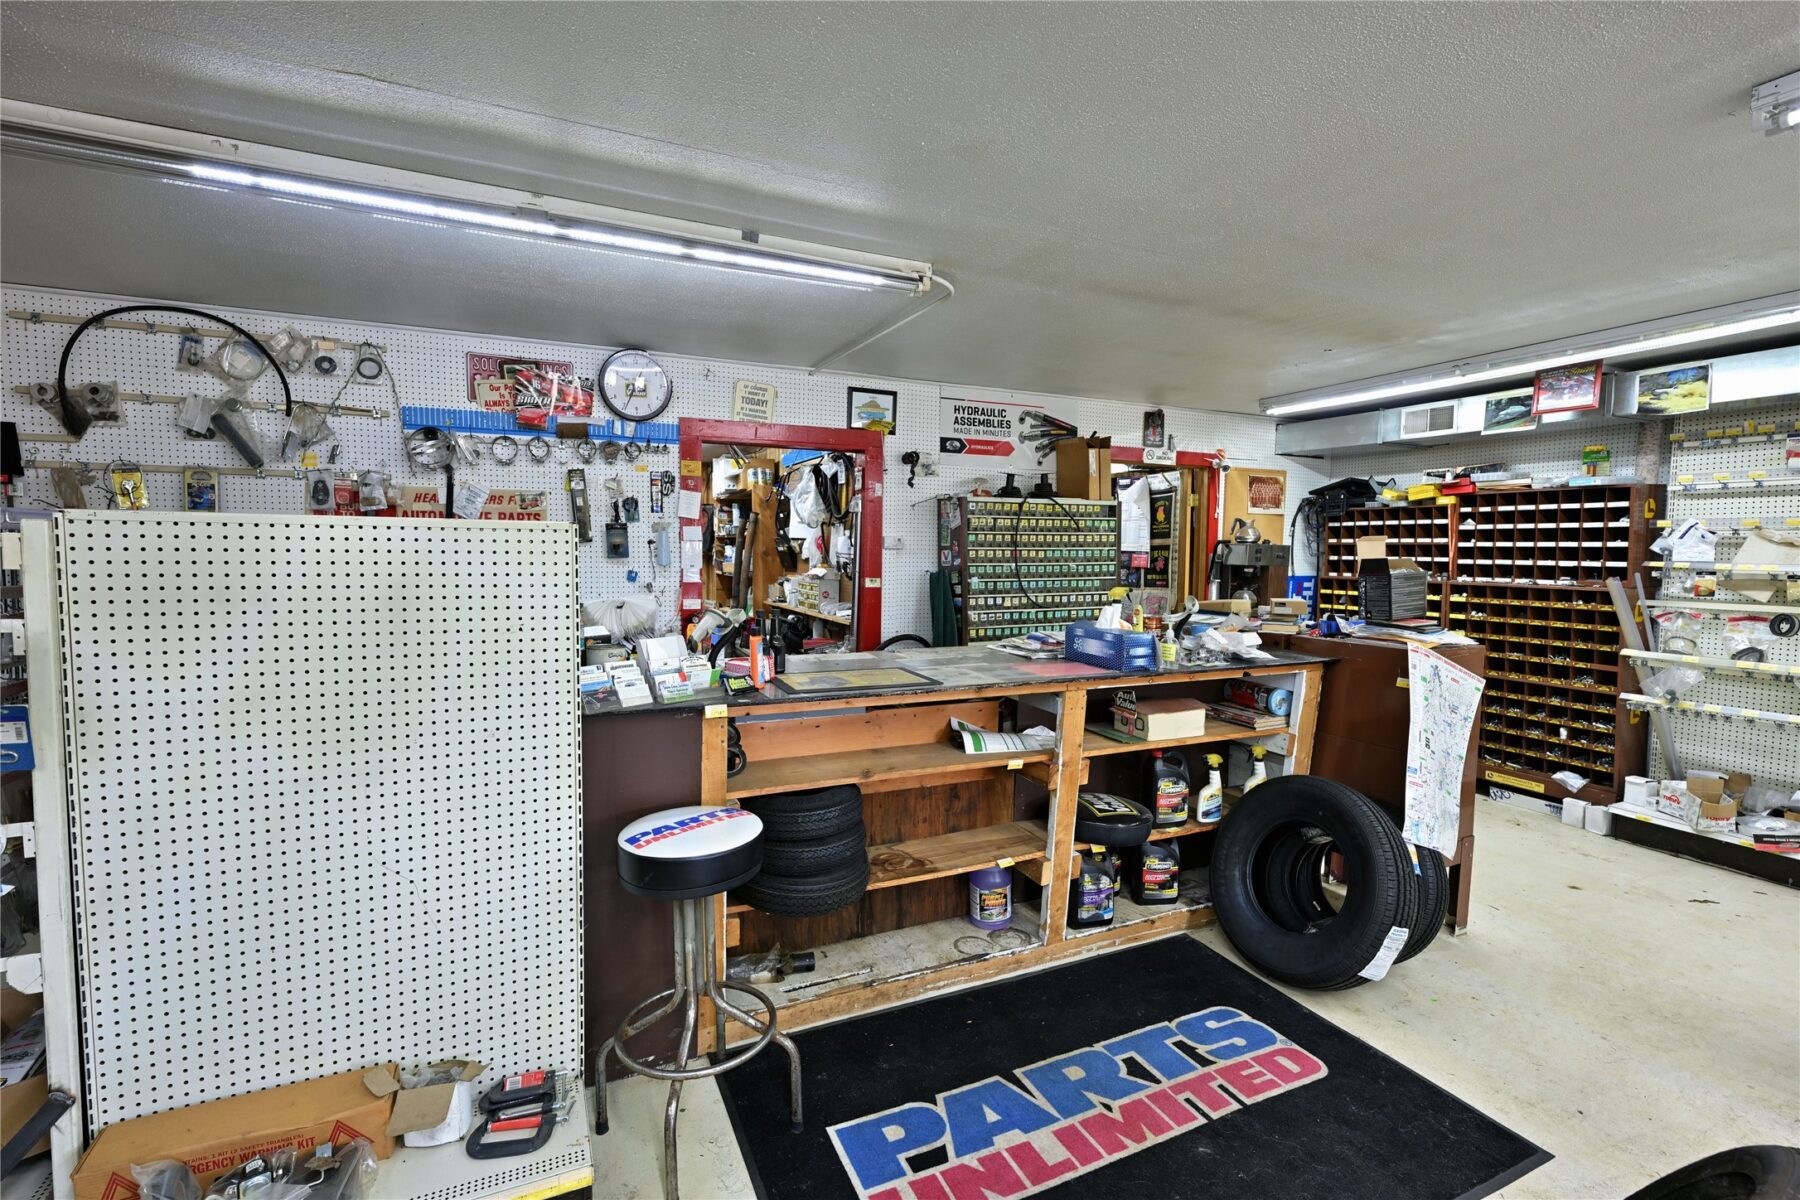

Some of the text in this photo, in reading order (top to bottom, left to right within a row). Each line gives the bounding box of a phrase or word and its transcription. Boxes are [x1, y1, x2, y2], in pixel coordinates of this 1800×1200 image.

[489, 384, 500, 392] Our
[484, 399, 510, 408] ALWAYS
[741, 396, 768, 408] TODAY!
[954, 405, 1007, 418] HYDRAULIC
[953, 416, 1012, 429] ASSEMBLIES
[953, 427, 1012, 438] MADE IN MINUTES
[498, 512, 541, 521] PARTS
[624, 808, 741, 845] PARTS
[633, 810, 753, 849] UNLIMITED
[828, 1006, 1281, 1193] PARTS
[864, 1046, 1327, 1200] NLIMITED
[240, 1143, 264, 1154] SAFETY
[191, 1156, 236, 1176] RGENCY
[297, 1136, 317, 1151] KIT
